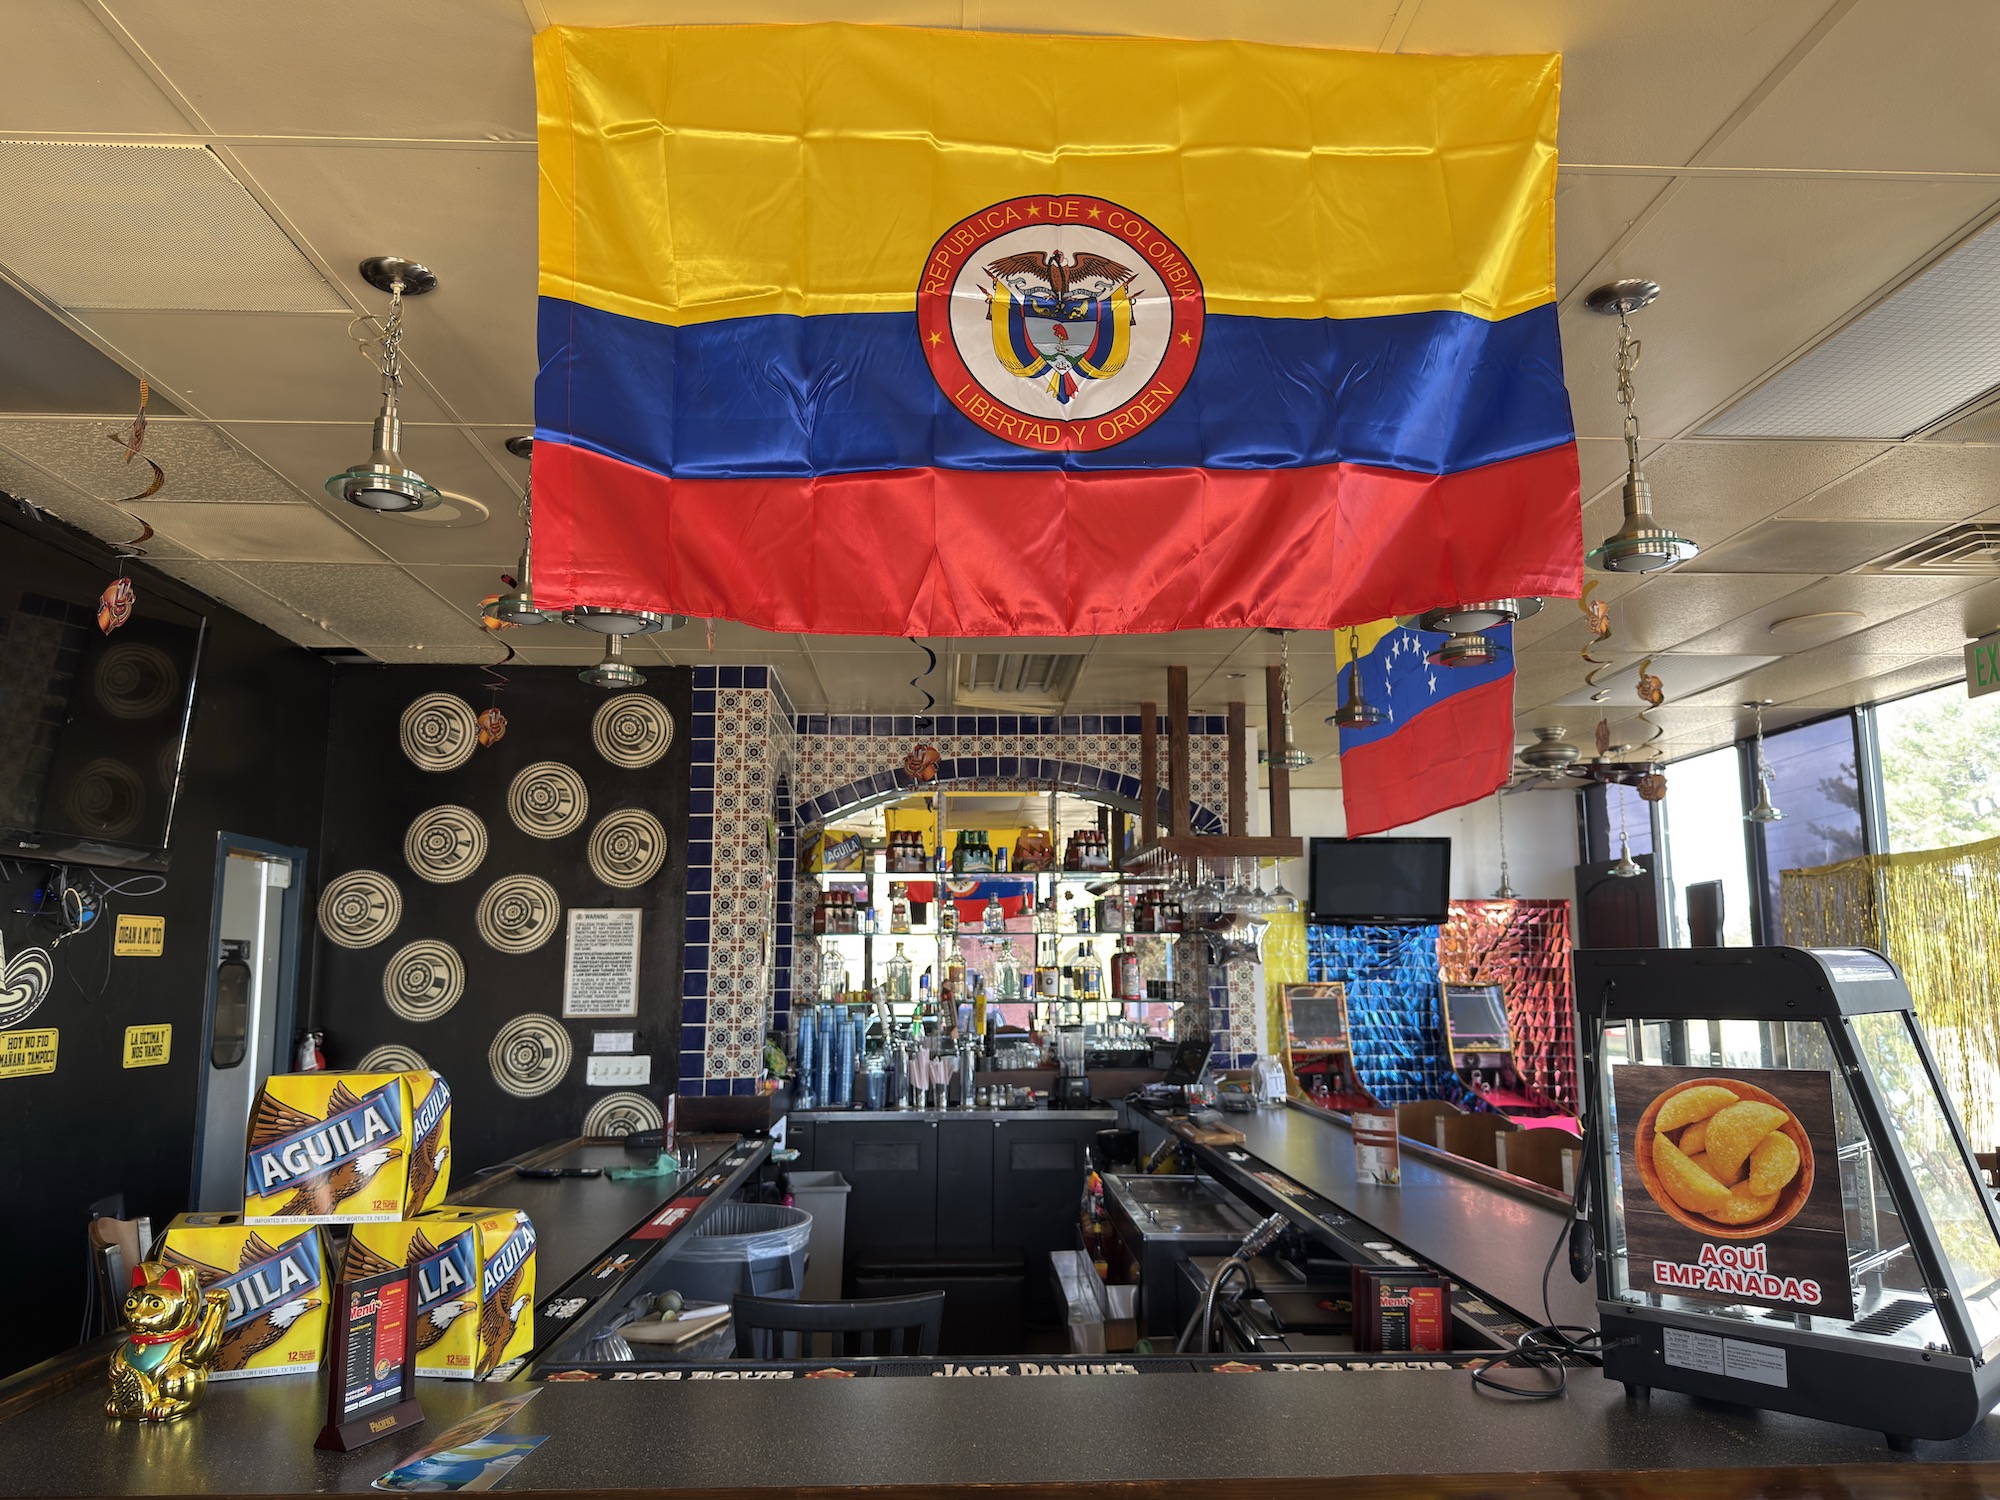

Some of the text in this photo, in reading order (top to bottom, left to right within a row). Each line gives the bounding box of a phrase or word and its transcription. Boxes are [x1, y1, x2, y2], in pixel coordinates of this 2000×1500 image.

[924, 200, 1196, 301] REPUBLICA DE COLOMBIA
[955, 381, 1173, 445] LIBERTAD Y ORDEN
[1974, 643, 2000, 687] EX
[826, 838, 859, 861] AGUILA
[8, 1035, 49, 1049] HOY NO FIO
[131, 1033, 138, 1045] LA
[161, 1031, 165, 1043] Y
[28, 1050, 55, 1064] TAMPOCO
[131, 1045, 163, 1059] NOS VAMOS
[413, 1081, 450, 1142] AGUILA
[260, 1106, 391, 1188] AGUILA
[372, 1200, 382, 1208] 12
[484, 1226, 535, 1294] AGUILA
[1700, 1243, 1766, 1273] AQUÍ
[228, 1256, 309, 1321] UILA
[1655, 1262, 1820, 1303] EMPANADAS
[350, 1299, 376, 1321] Menú
[1380, 1295, 1407, 1307] Menú
[288, 1352, 297, 1361] 12
[932, 1363, 1011, 1377] JACK
[369, 1416, 397, 1433] PACIFICO
